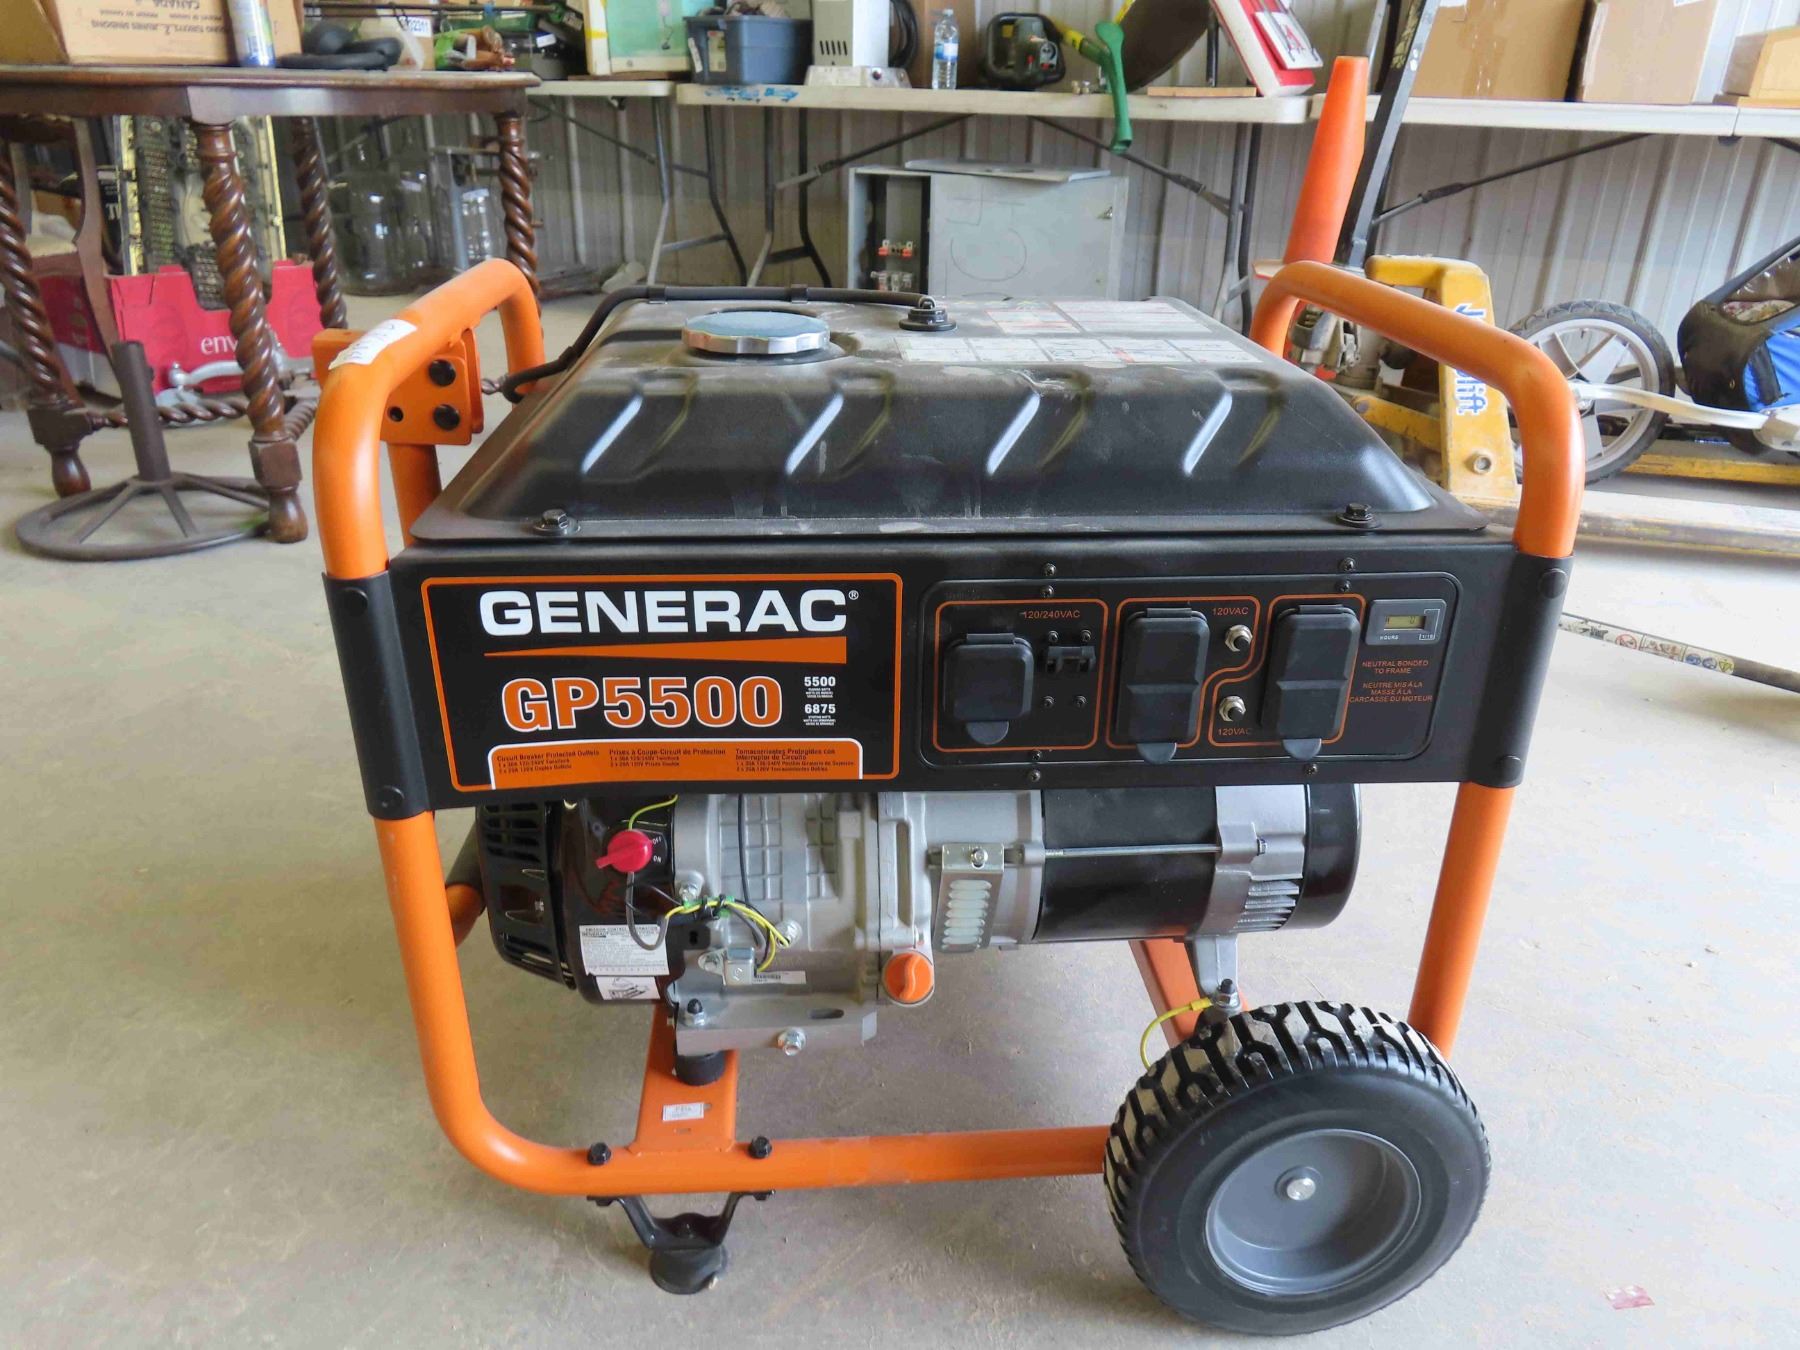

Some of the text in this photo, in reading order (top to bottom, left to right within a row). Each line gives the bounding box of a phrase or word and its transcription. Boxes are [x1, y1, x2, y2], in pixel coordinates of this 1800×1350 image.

[1023, 609, 1081, 619] 120/240VAC
[1212, 607, 1249, 616] 120VAC
[1397, 659, 1429, 667] BONDED
[804, 676, 836, 687] 5500
[501, 675, 782, 733] GP5500
[804, 703, 836, 714] 6875
[1217, 728, 1253, 737] 120VAC
[653, 855, 662, 863] ON
